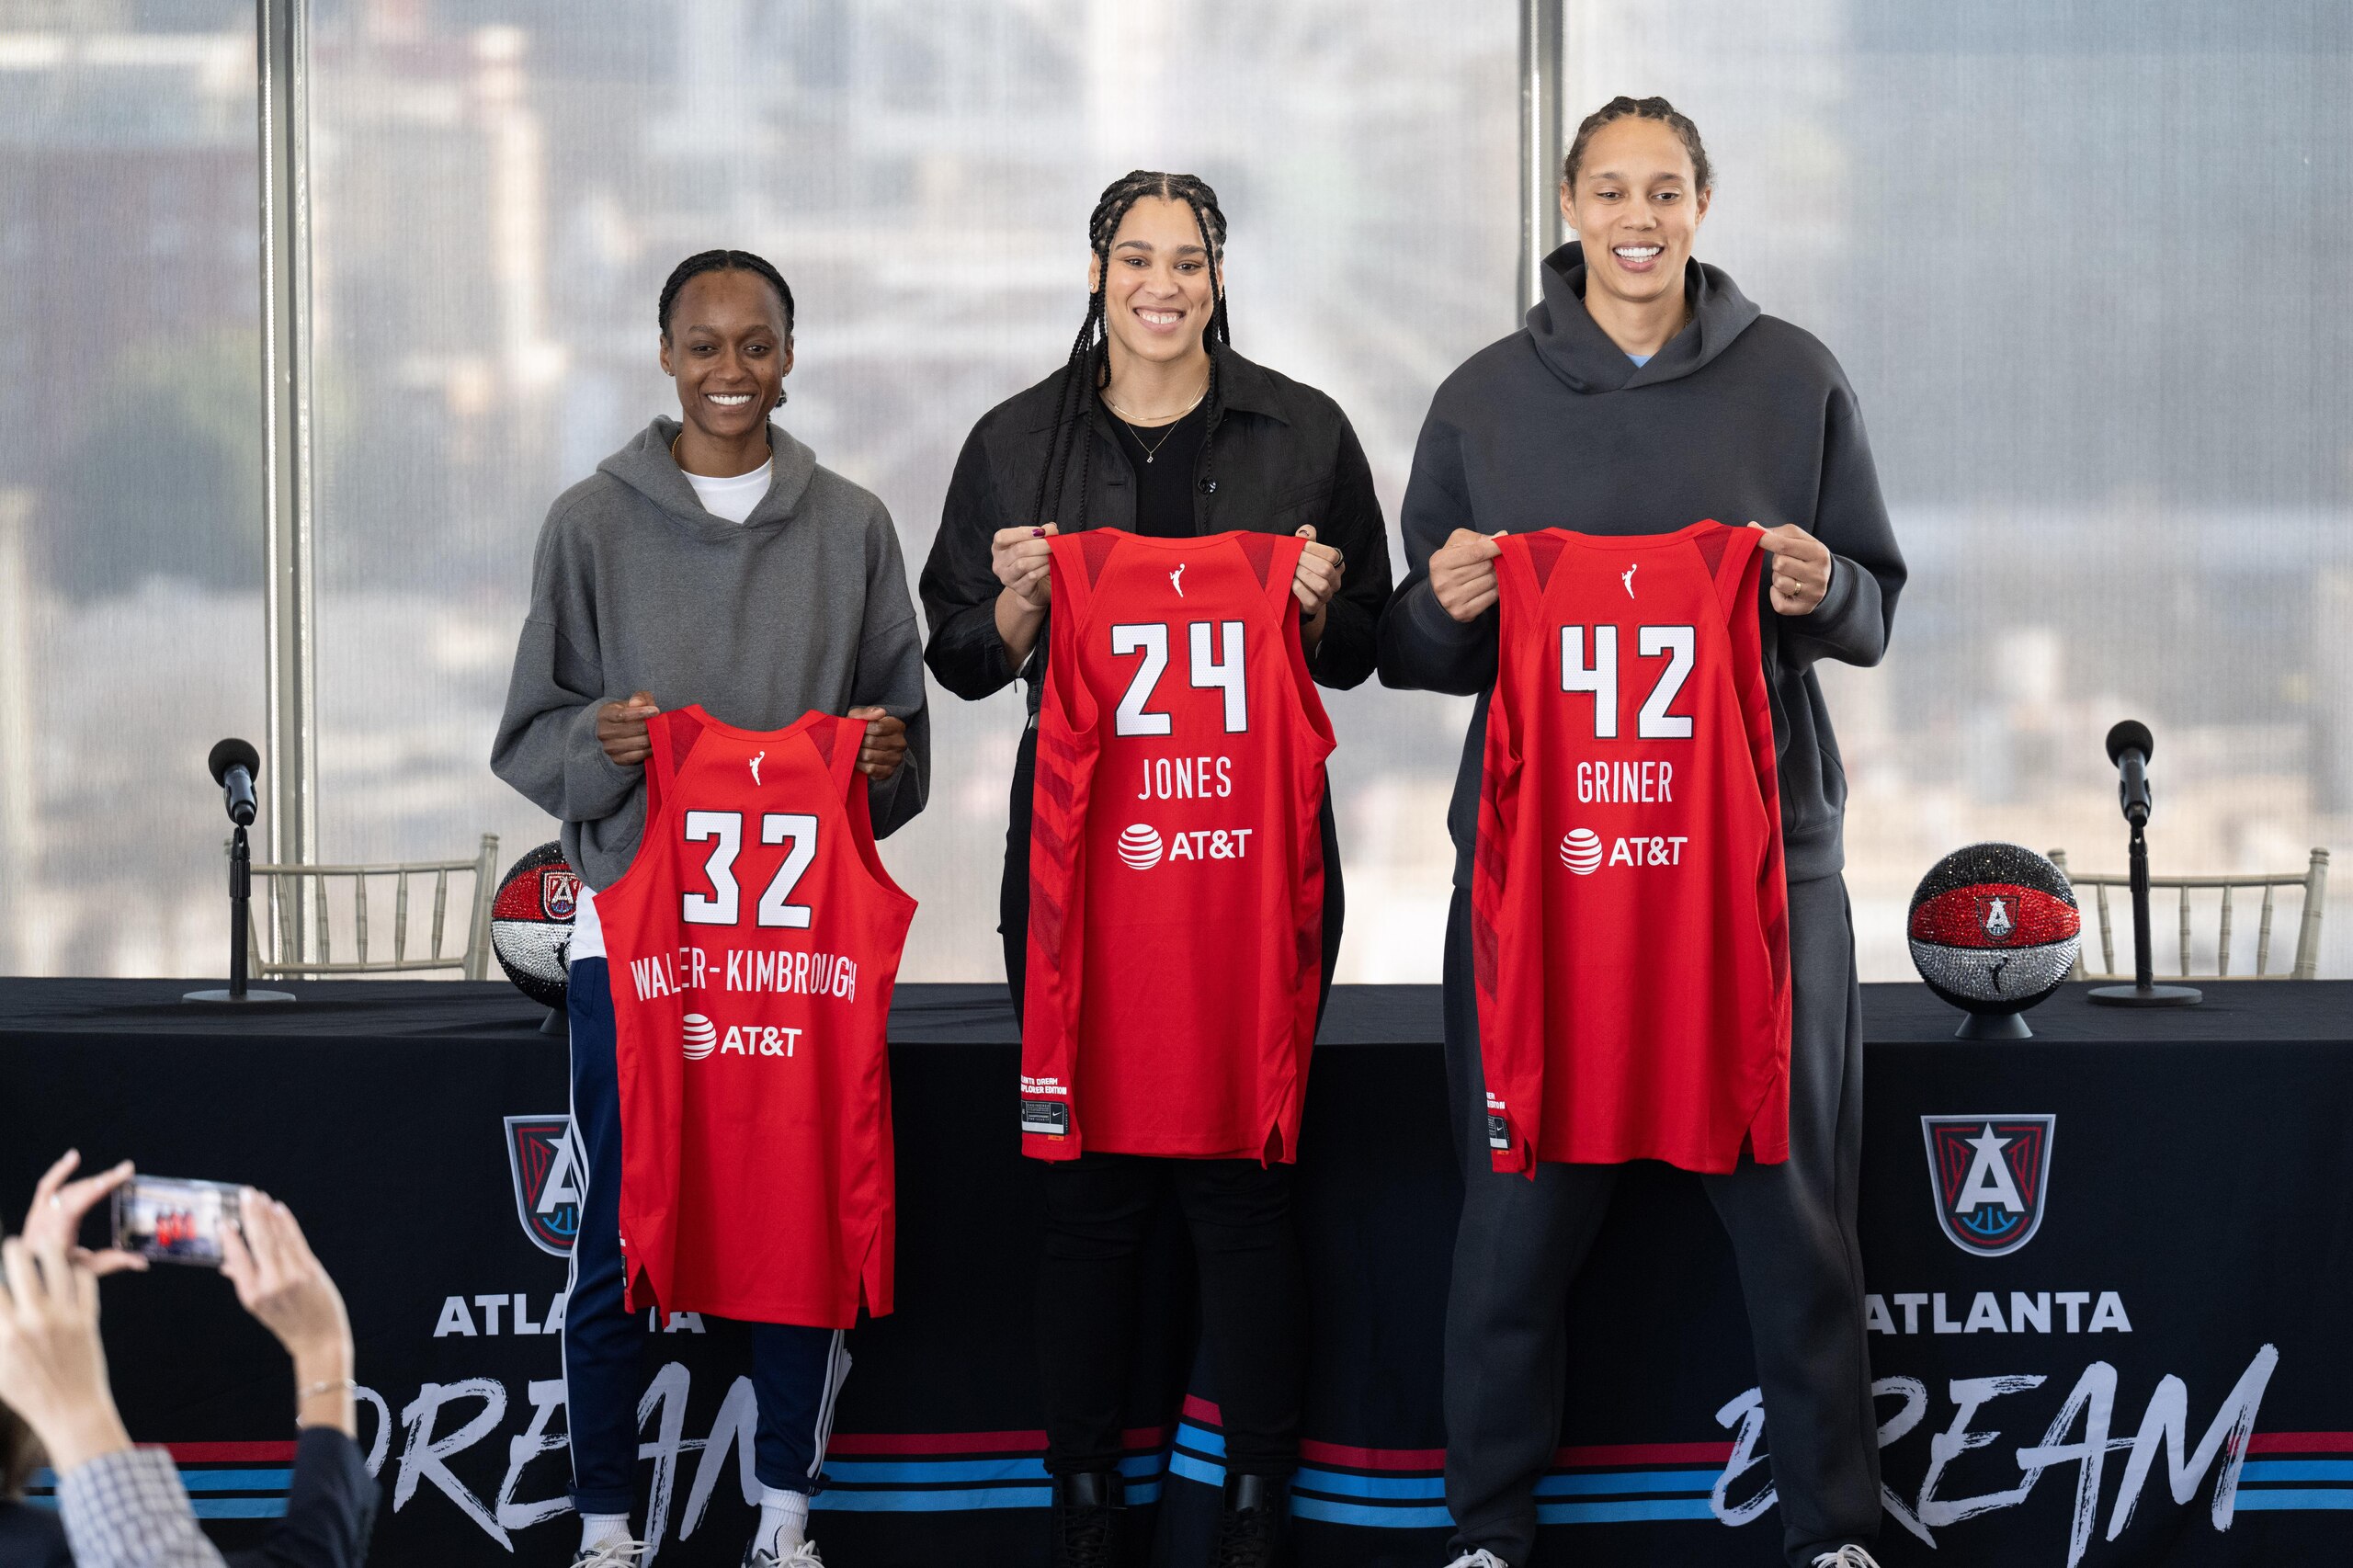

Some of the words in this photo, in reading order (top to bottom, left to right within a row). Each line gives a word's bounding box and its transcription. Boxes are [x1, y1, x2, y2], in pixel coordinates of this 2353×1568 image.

[1110, 620, 1249, 737] 24
[1560, 624, 1696, 739] 42
[1138, 756, 1232, 801] JONES
[1576, 761, 1673, 803] GRINER
[1168, 828, 1253, 861] AT&T
[1608, 835, 1688, 867] AT&T
[682, 809, 820, 929] 32
[721, 1025, 802, 1058] AT&T
[433, 1292, 707, 1337] ATLA
[1864, 1291, 2133, 1335] ATLANTA
